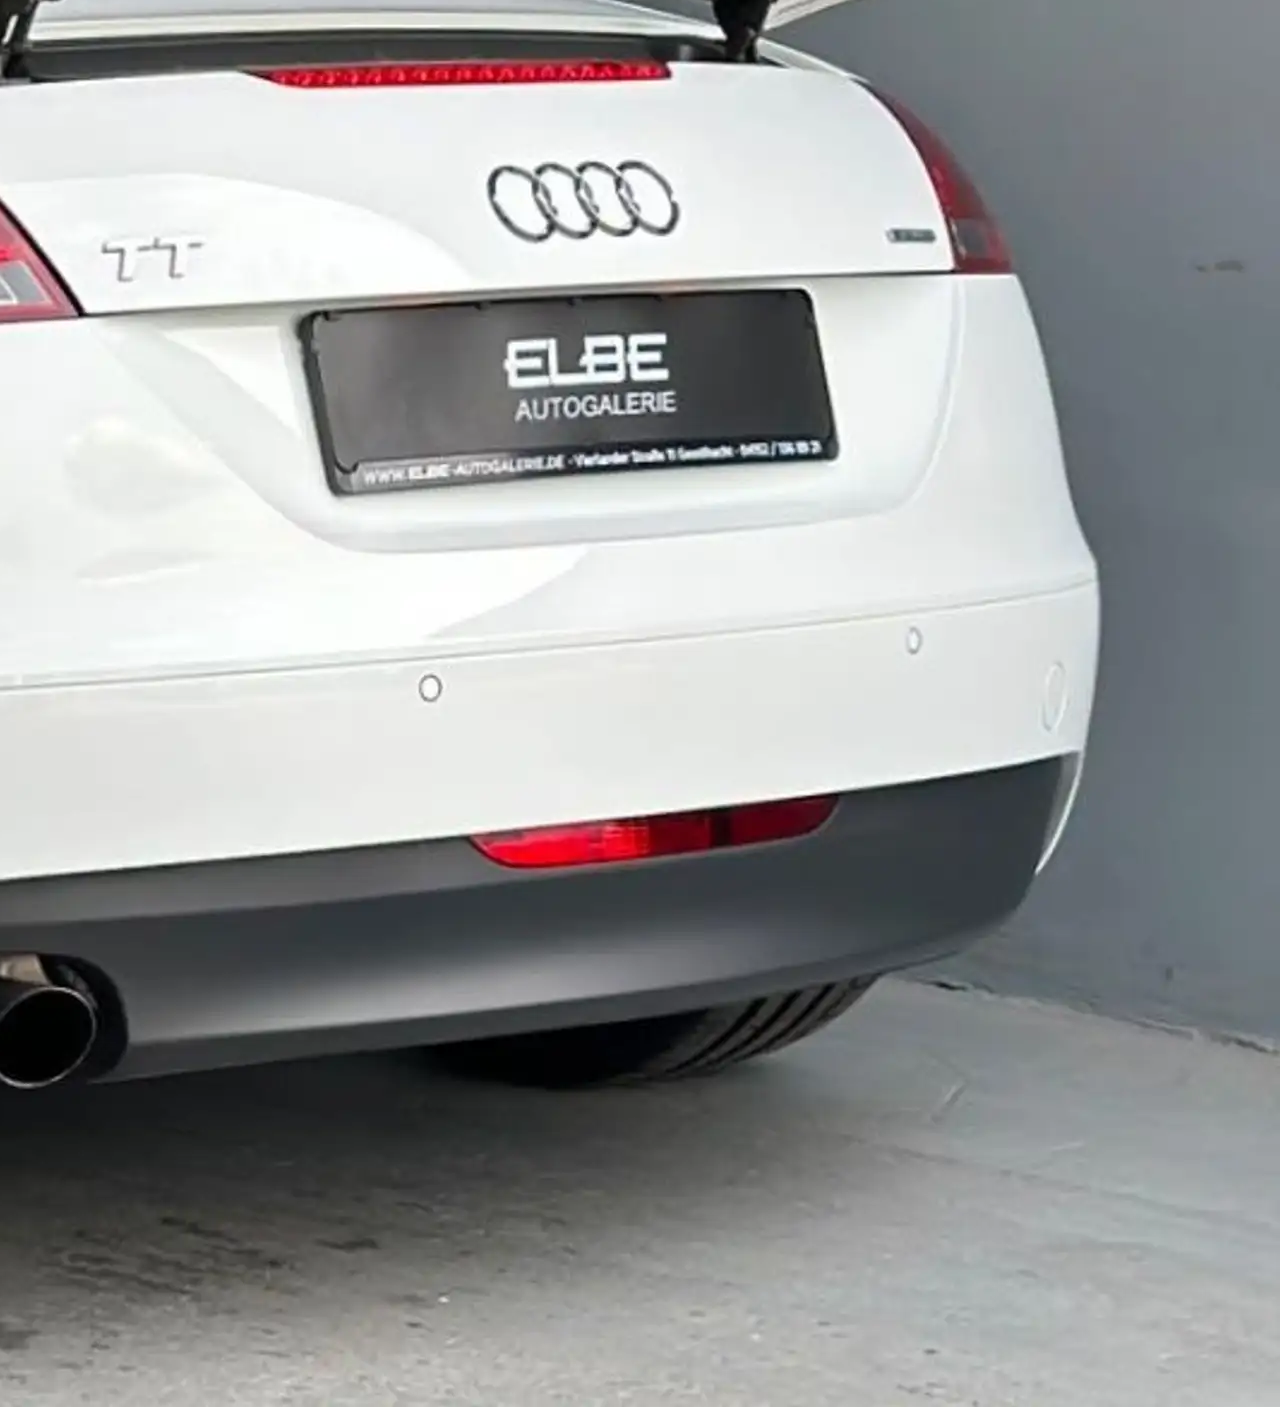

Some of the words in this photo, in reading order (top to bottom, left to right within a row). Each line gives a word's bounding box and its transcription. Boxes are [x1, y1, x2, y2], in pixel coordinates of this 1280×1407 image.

[100, 237, 205, 283] TT
[503, 332, 670, 389] ELBE
[514, 390, 677, 423] AUTOGALERIE
